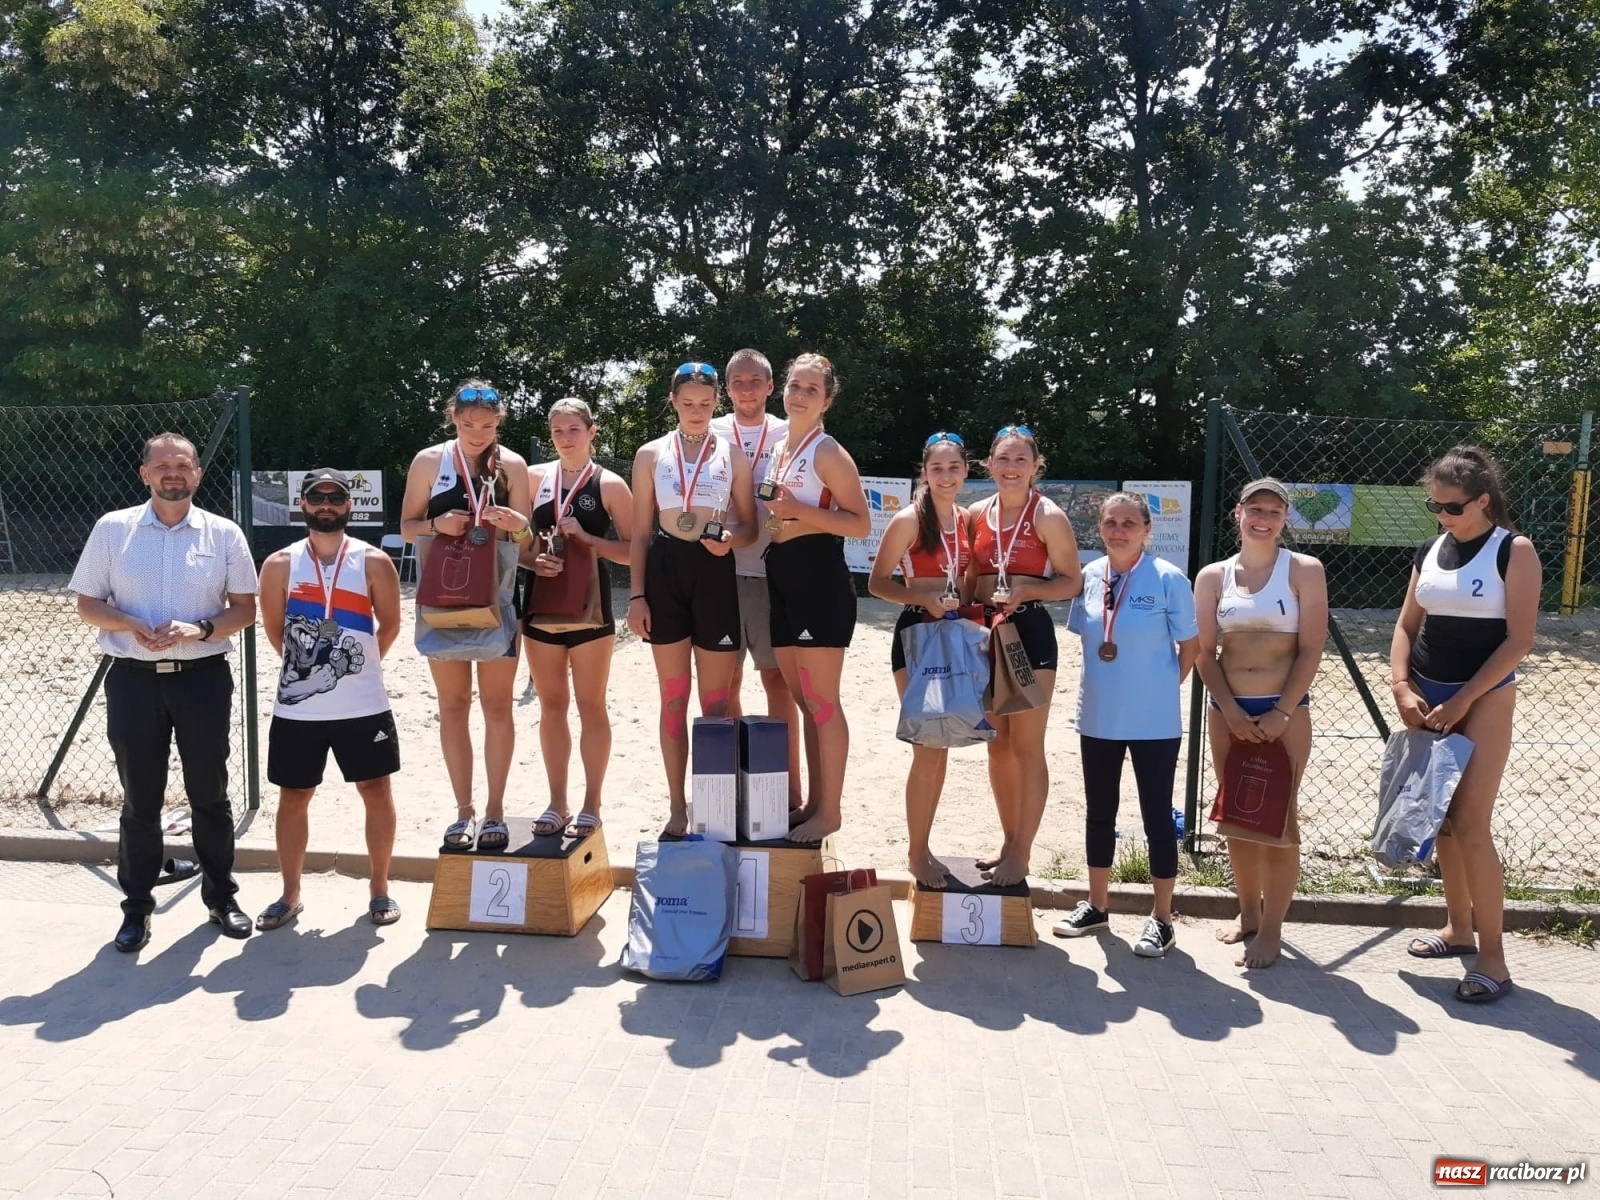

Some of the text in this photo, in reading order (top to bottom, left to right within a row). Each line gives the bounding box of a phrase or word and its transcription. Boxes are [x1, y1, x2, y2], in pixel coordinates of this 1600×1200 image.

[797, 458, 807, 473] 2
[351, 512, 370, 521] 882
[1023, 521, 1032, 536] 2
[1471, 578, 1484, 597] 2
[1276, 599, 1286, 616] 1
[486, 868, 511, 918] 2
[736, 858, 758, 932] 1
[960, 894, 985, 945] 3
[842, 956, 890, 973] mediaexpert
